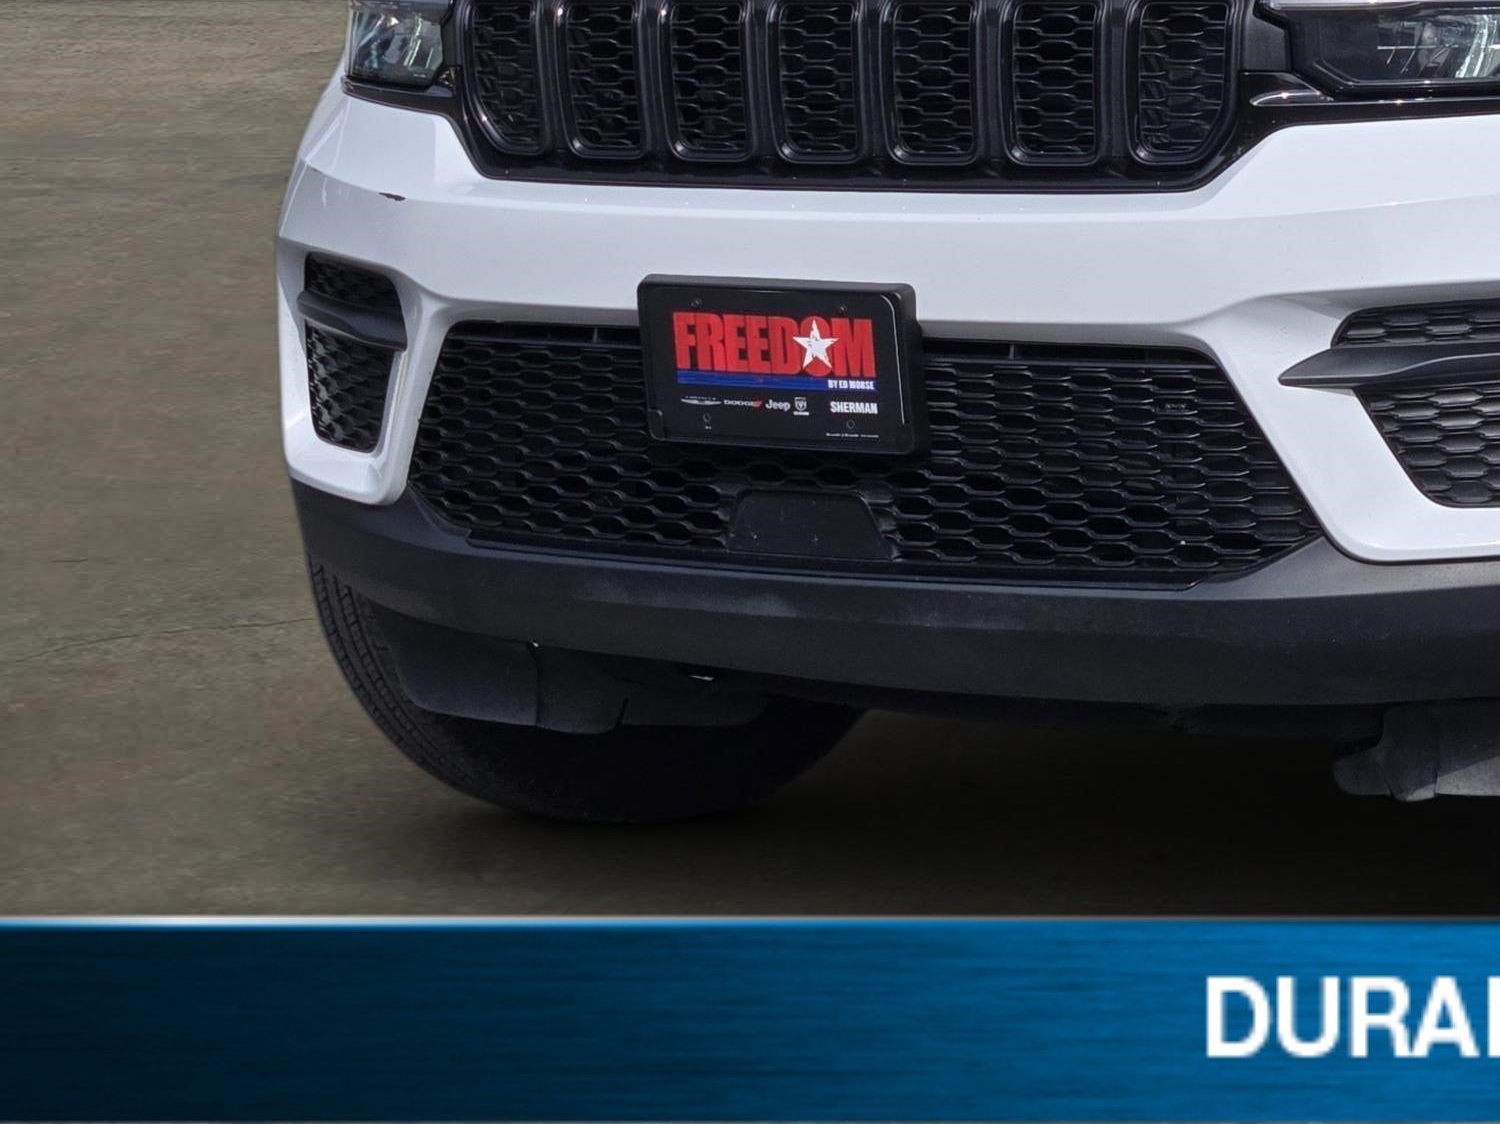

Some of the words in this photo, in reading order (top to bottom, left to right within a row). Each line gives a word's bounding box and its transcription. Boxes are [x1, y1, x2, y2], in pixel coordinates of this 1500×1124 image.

[672, 311, 877, 378] FREEDOM
[828, 379, 838, 389] BY
[838, 379, 849, 389] ED
[765, 399, 791, 412] Jeep
[830, 401, 878, 415] SHERMAN
